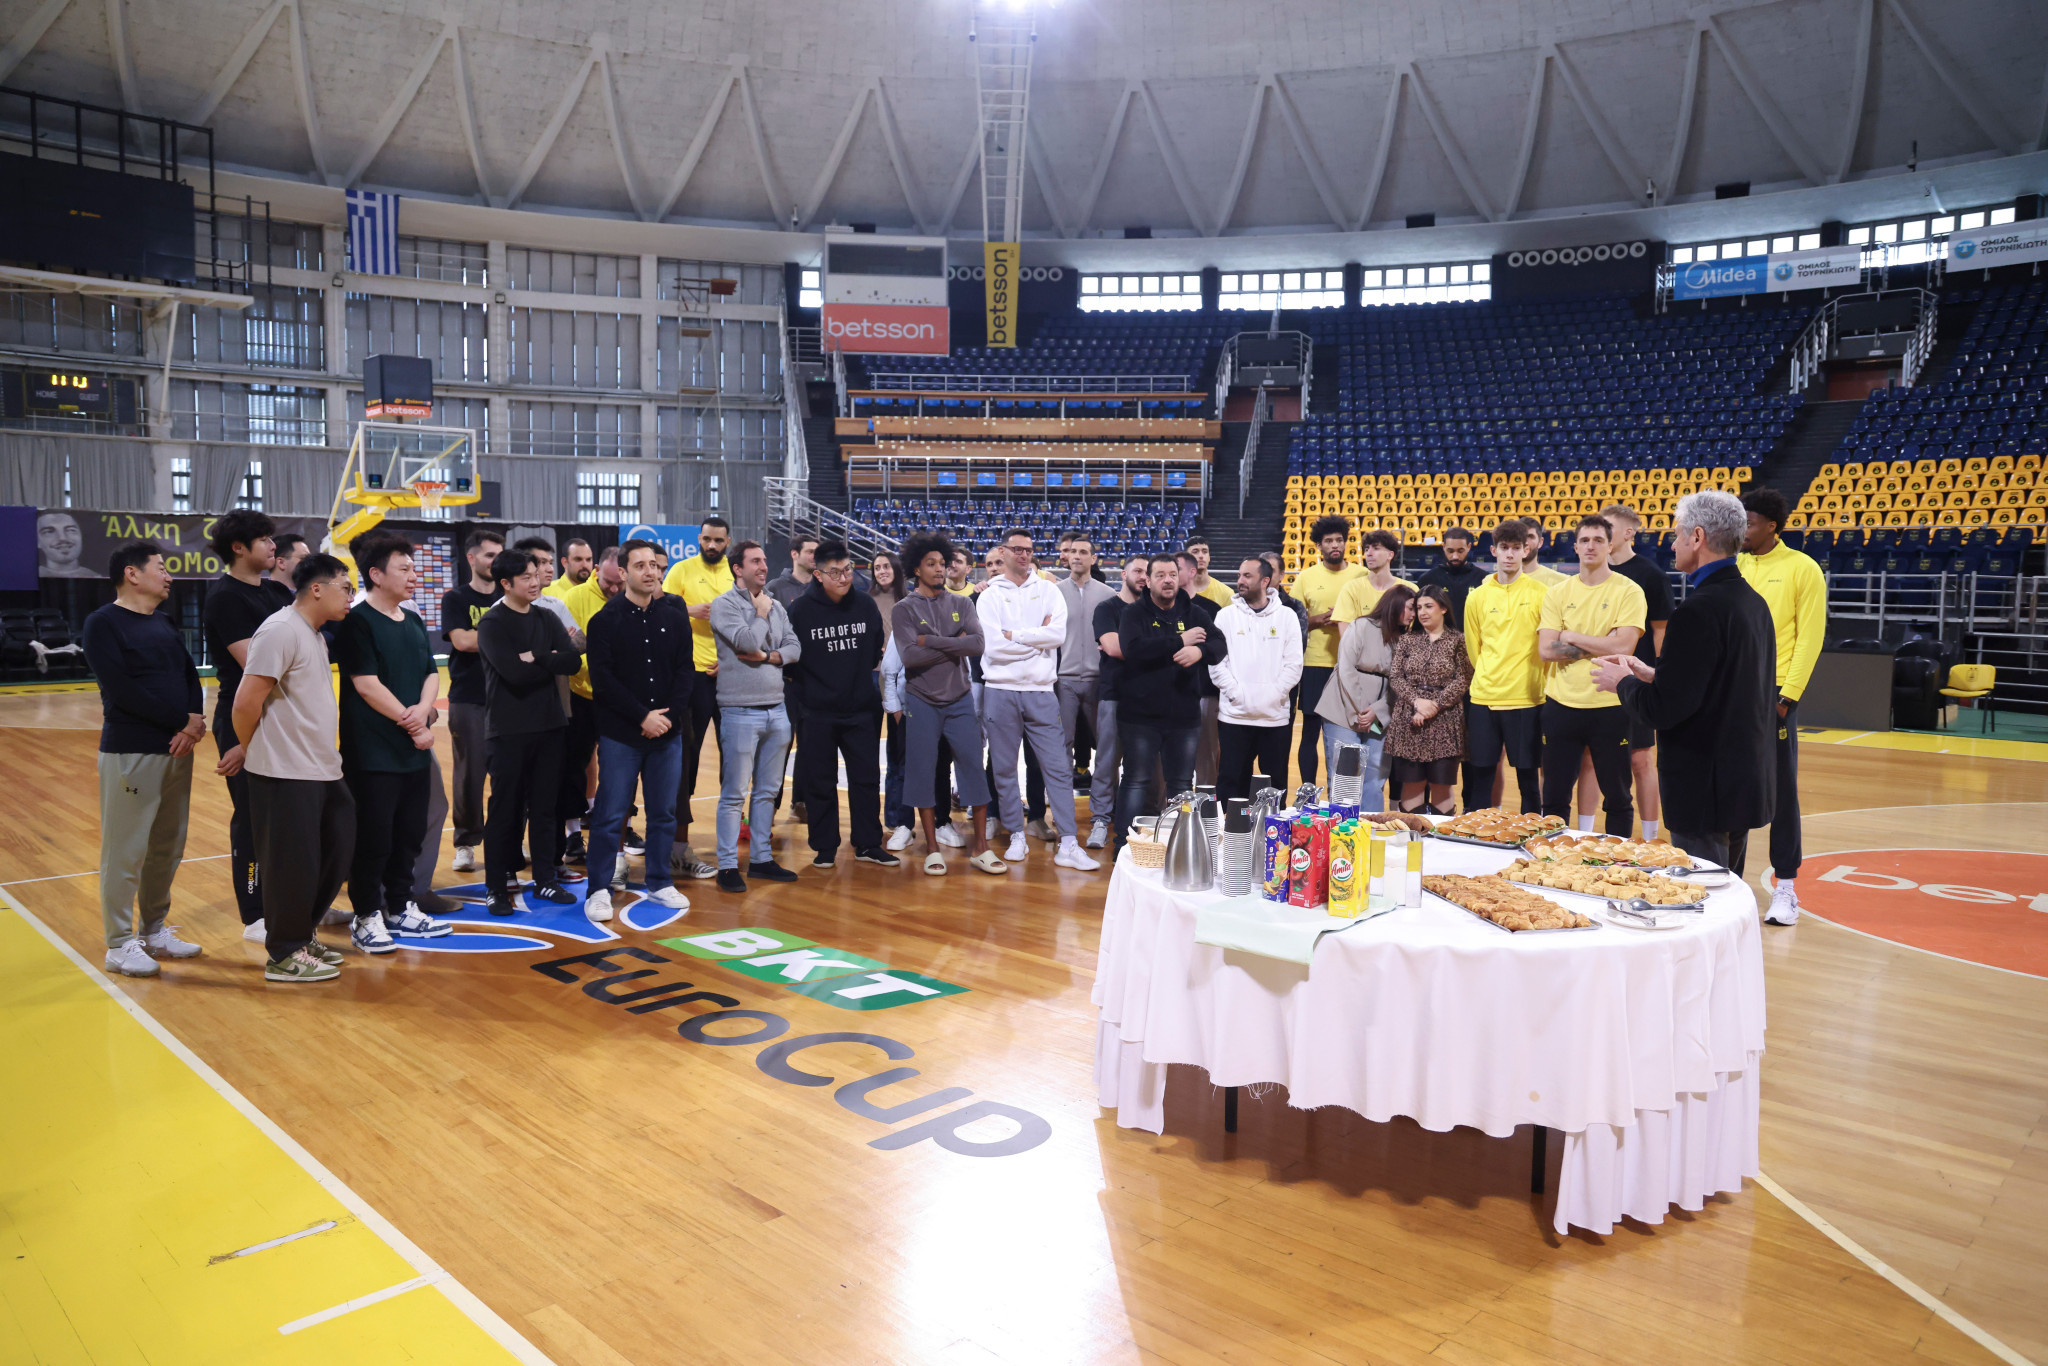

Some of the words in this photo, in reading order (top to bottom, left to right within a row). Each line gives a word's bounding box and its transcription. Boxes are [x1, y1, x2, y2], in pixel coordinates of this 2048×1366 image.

[1697, 267, 1757, 285] Midea
[989, 249, 1008, 344] betsson
[828, 317, 935, 339] betsson
[386, 406, 425, 415] betsson
[101, 515, 180, 546] Άλκη
[811, 627, 836, 640] FEAR
[838, 624, 849, 637] OF
[851, 622, 866, 635] GOD
[827, 637, 858, 652] STATE
[1292, 852, 1309, 866] Amita
[1331, 861, 1352, 876] Amita
[682, 929, 941, 1000] BKT
[529, 946, 1053, 1158] EuroCup
